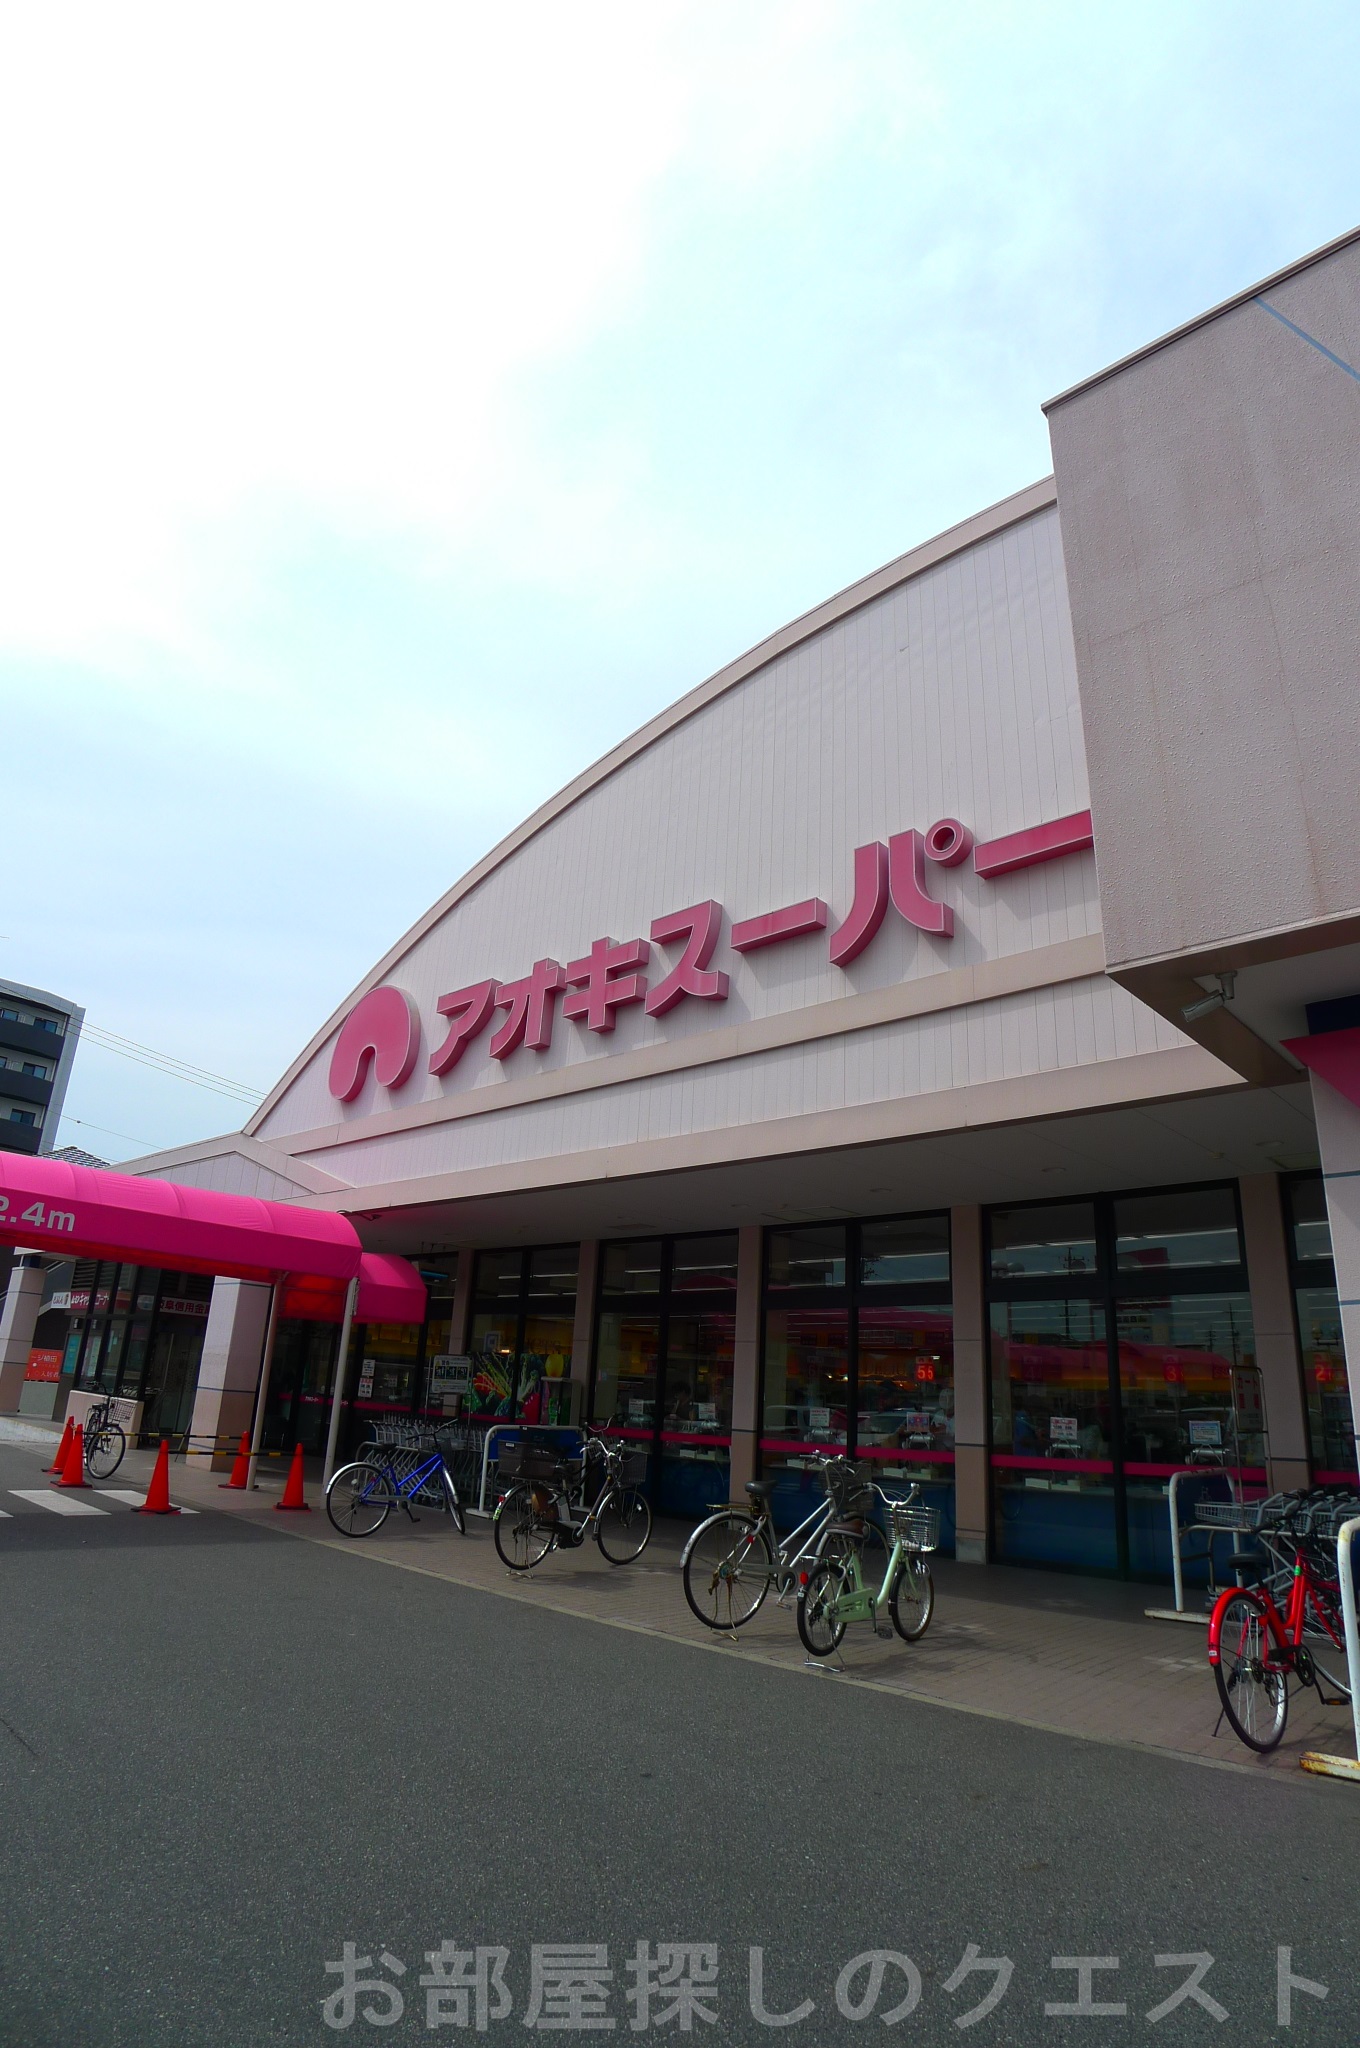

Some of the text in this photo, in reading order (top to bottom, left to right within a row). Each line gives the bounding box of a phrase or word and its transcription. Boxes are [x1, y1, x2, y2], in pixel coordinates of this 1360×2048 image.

[428, 808, 1093, 1077] アオキスーパー
